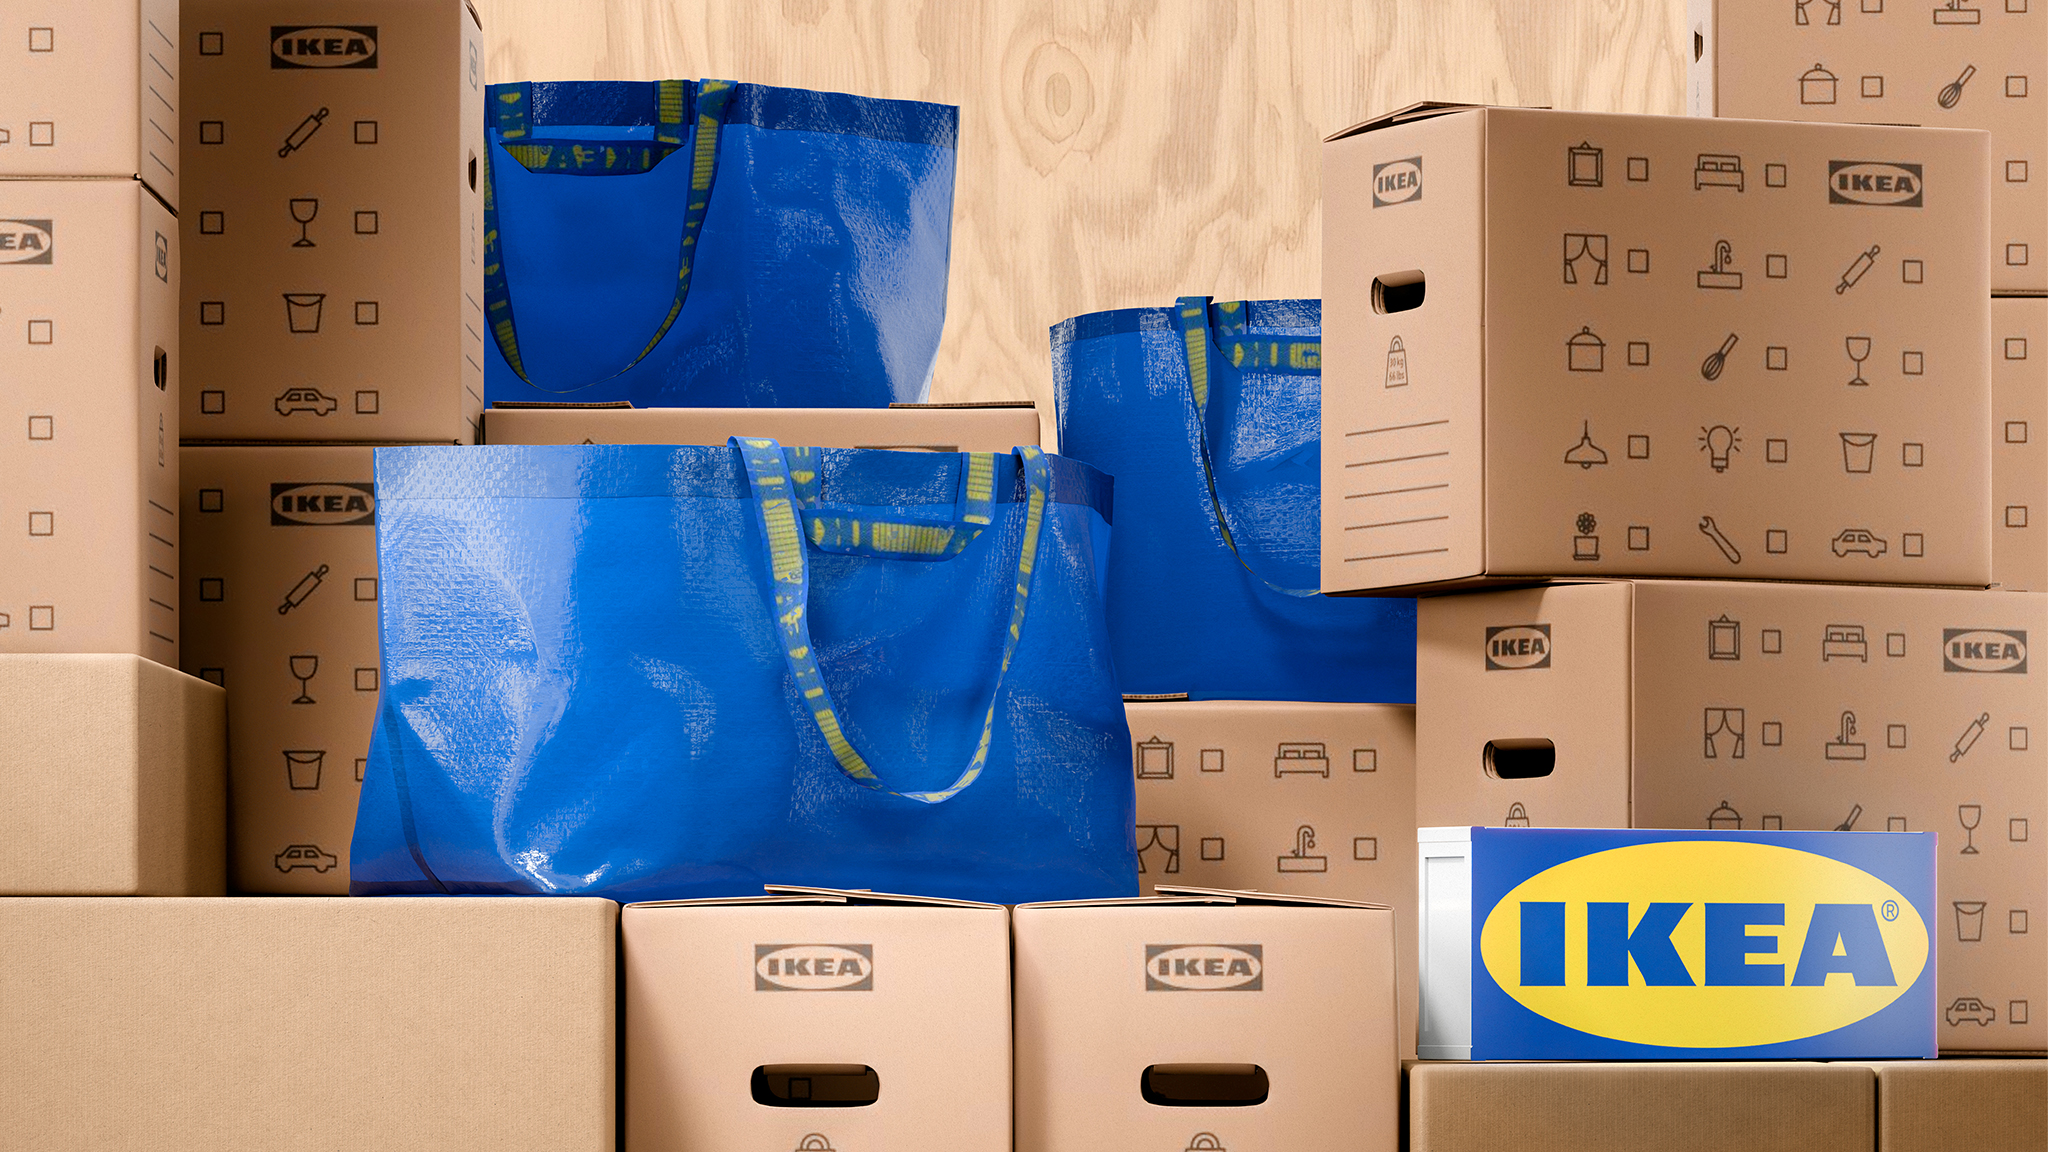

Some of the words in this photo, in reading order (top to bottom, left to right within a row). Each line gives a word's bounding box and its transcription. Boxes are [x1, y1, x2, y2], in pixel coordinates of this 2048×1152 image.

[282, 38, 368, 55] IKEA
[1378, 170, 1418, 194] IKEA
[1838, 173, 1915, 193] IKEA
[0, 233, 44, 250] EA
[282, 495, 368, 512] IKEA
[1492, 638, 1545, 657] IKEA
[1952, 642, 2020, 660] IKEA
[768, 958, 862, 976] IKEA
[1158, 958, 1253, 976] IKEA
